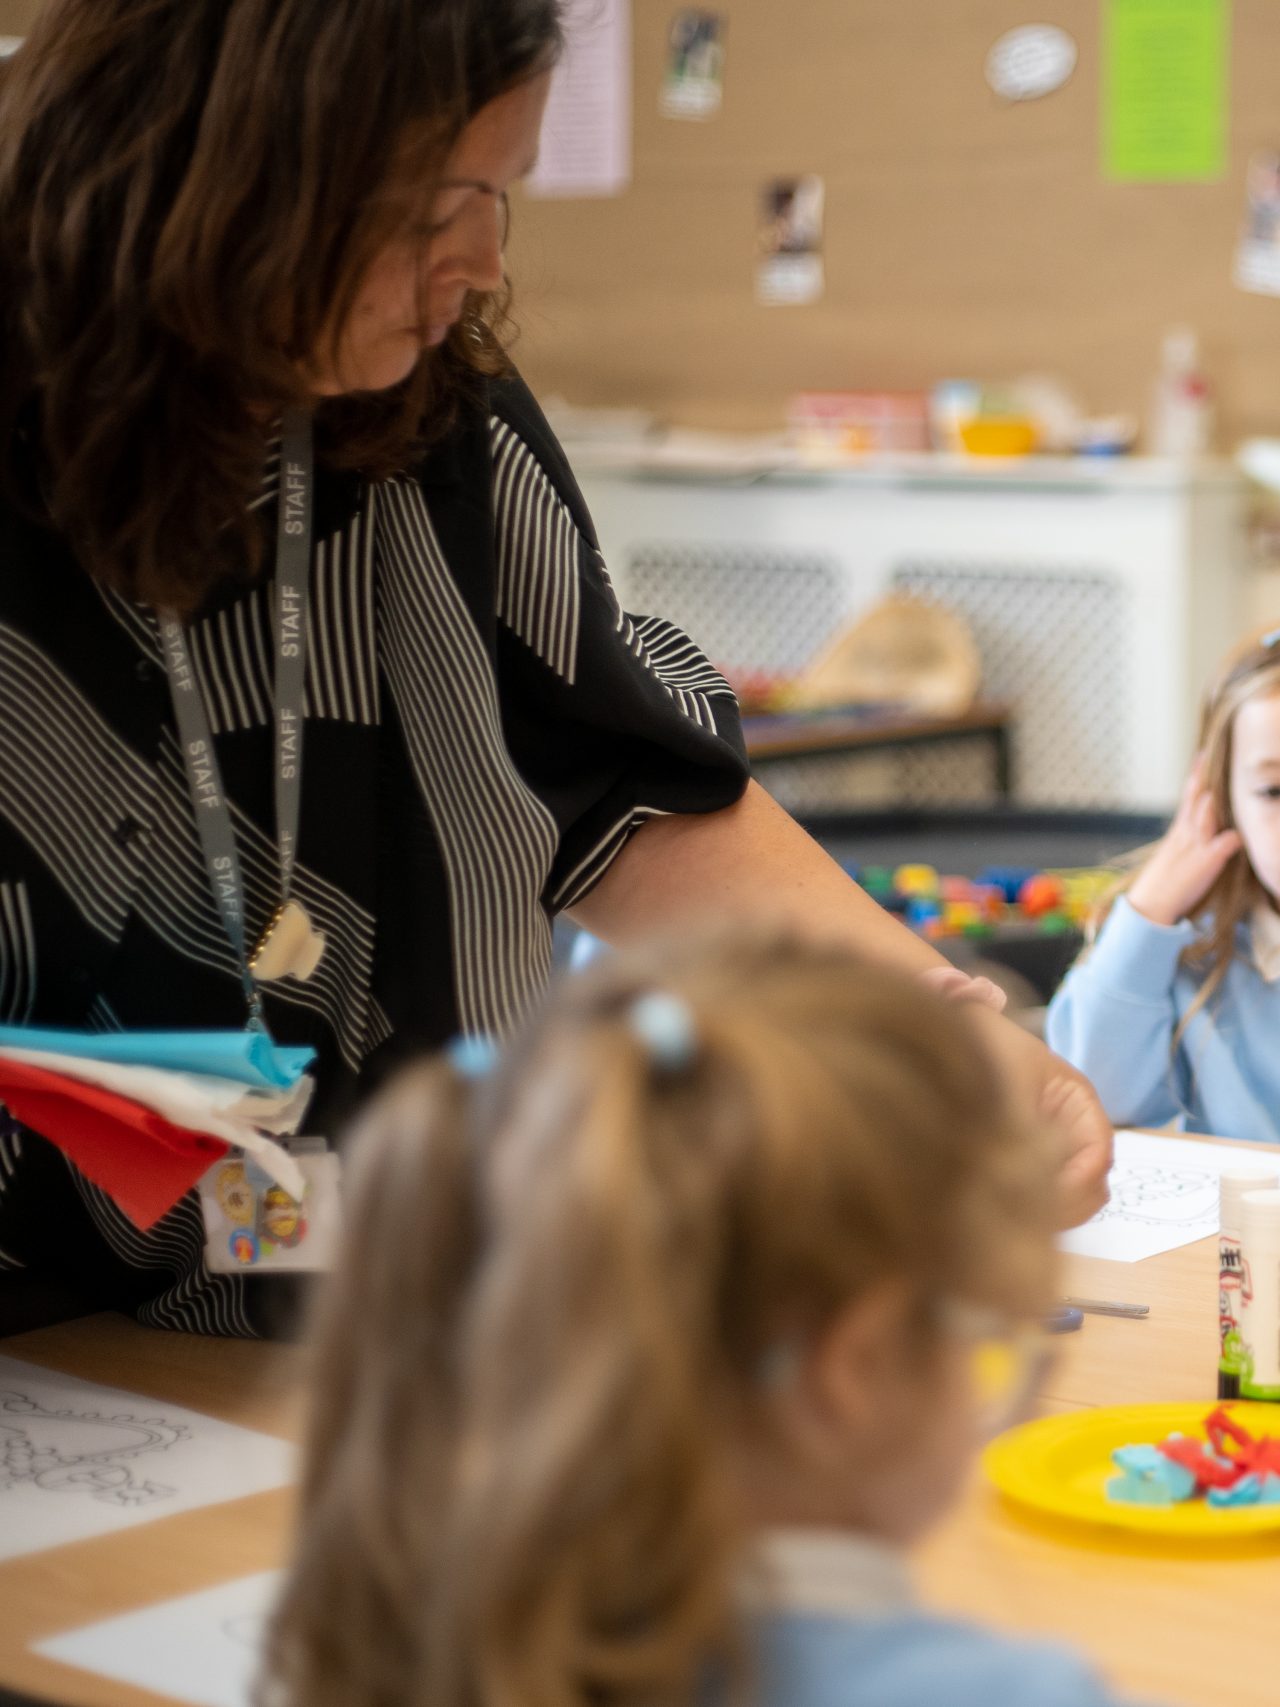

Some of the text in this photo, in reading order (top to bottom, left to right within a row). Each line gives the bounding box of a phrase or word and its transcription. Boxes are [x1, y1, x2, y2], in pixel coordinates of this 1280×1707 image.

[285, 462, 306, 535] STAFF
[281, 585, 301, 657] STAFF
[165, 622, 192, 692] STAFF
[189, 739, 219, 809] STAFF
[281, 708, 297, 779] STAFF
[213, 855, 239, 923] STAFF
